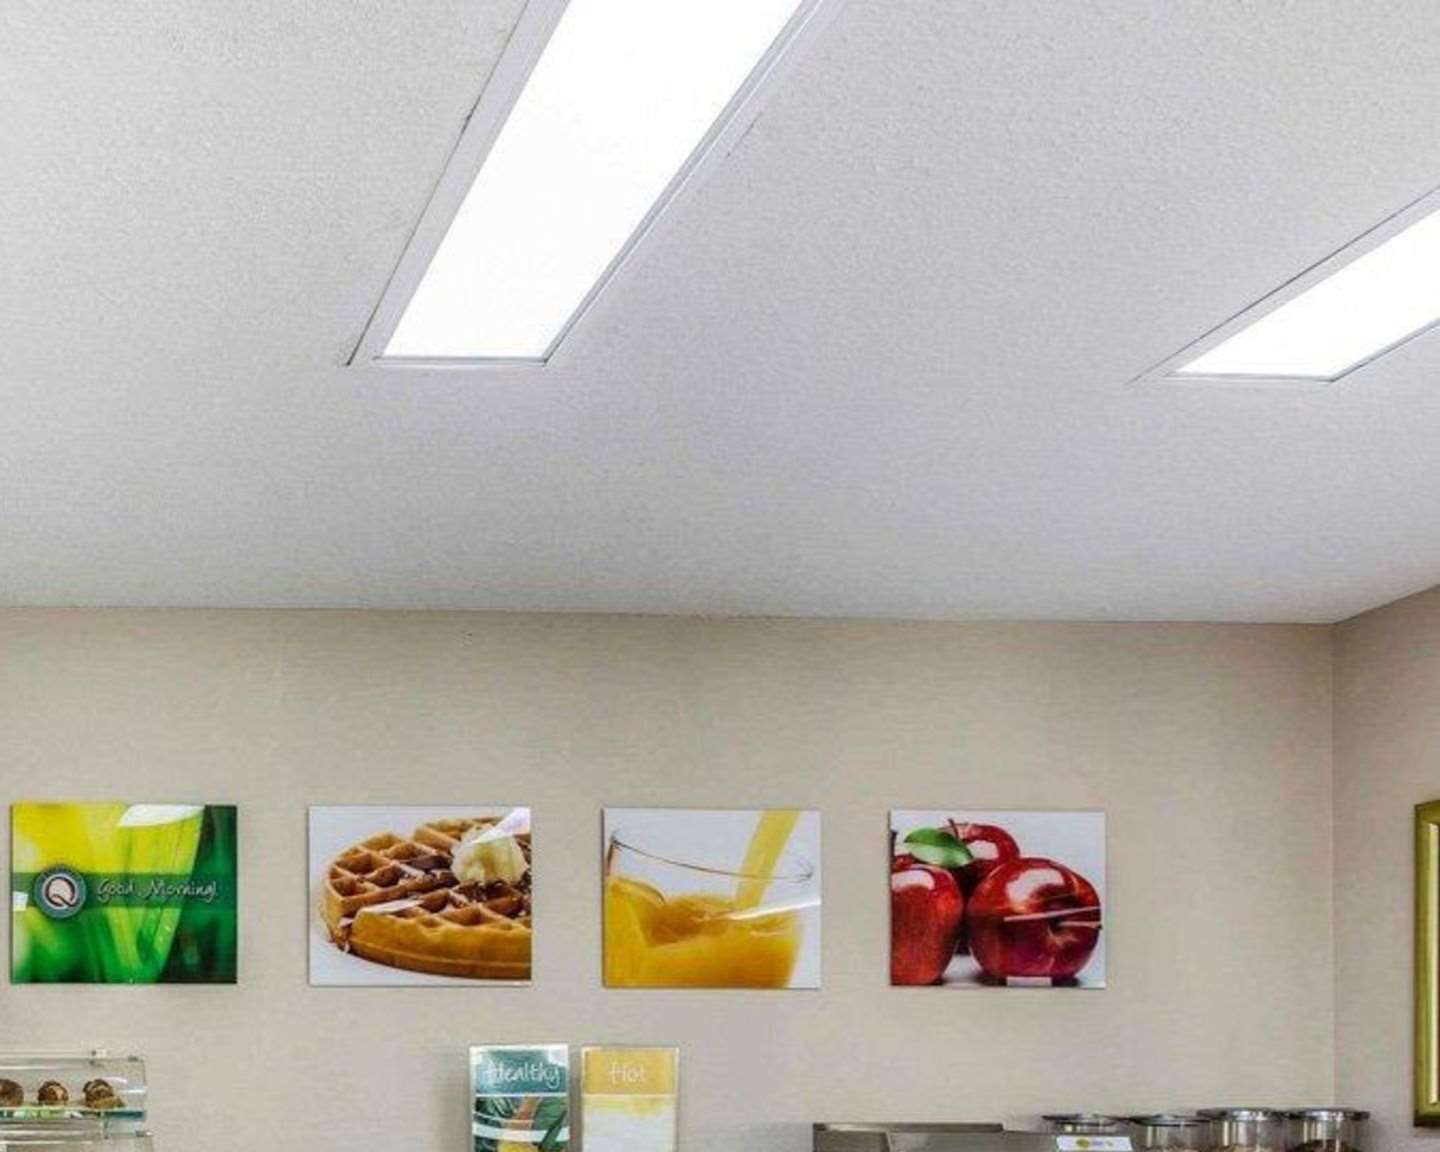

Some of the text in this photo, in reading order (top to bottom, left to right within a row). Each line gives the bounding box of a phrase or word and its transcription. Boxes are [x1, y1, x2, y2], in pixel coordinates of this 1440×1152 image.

[96, 878, 218, 903] Good Morning!
[485, 1059, 560, 1089] Healthy
[609, 1061, 647, 1084] Hot
